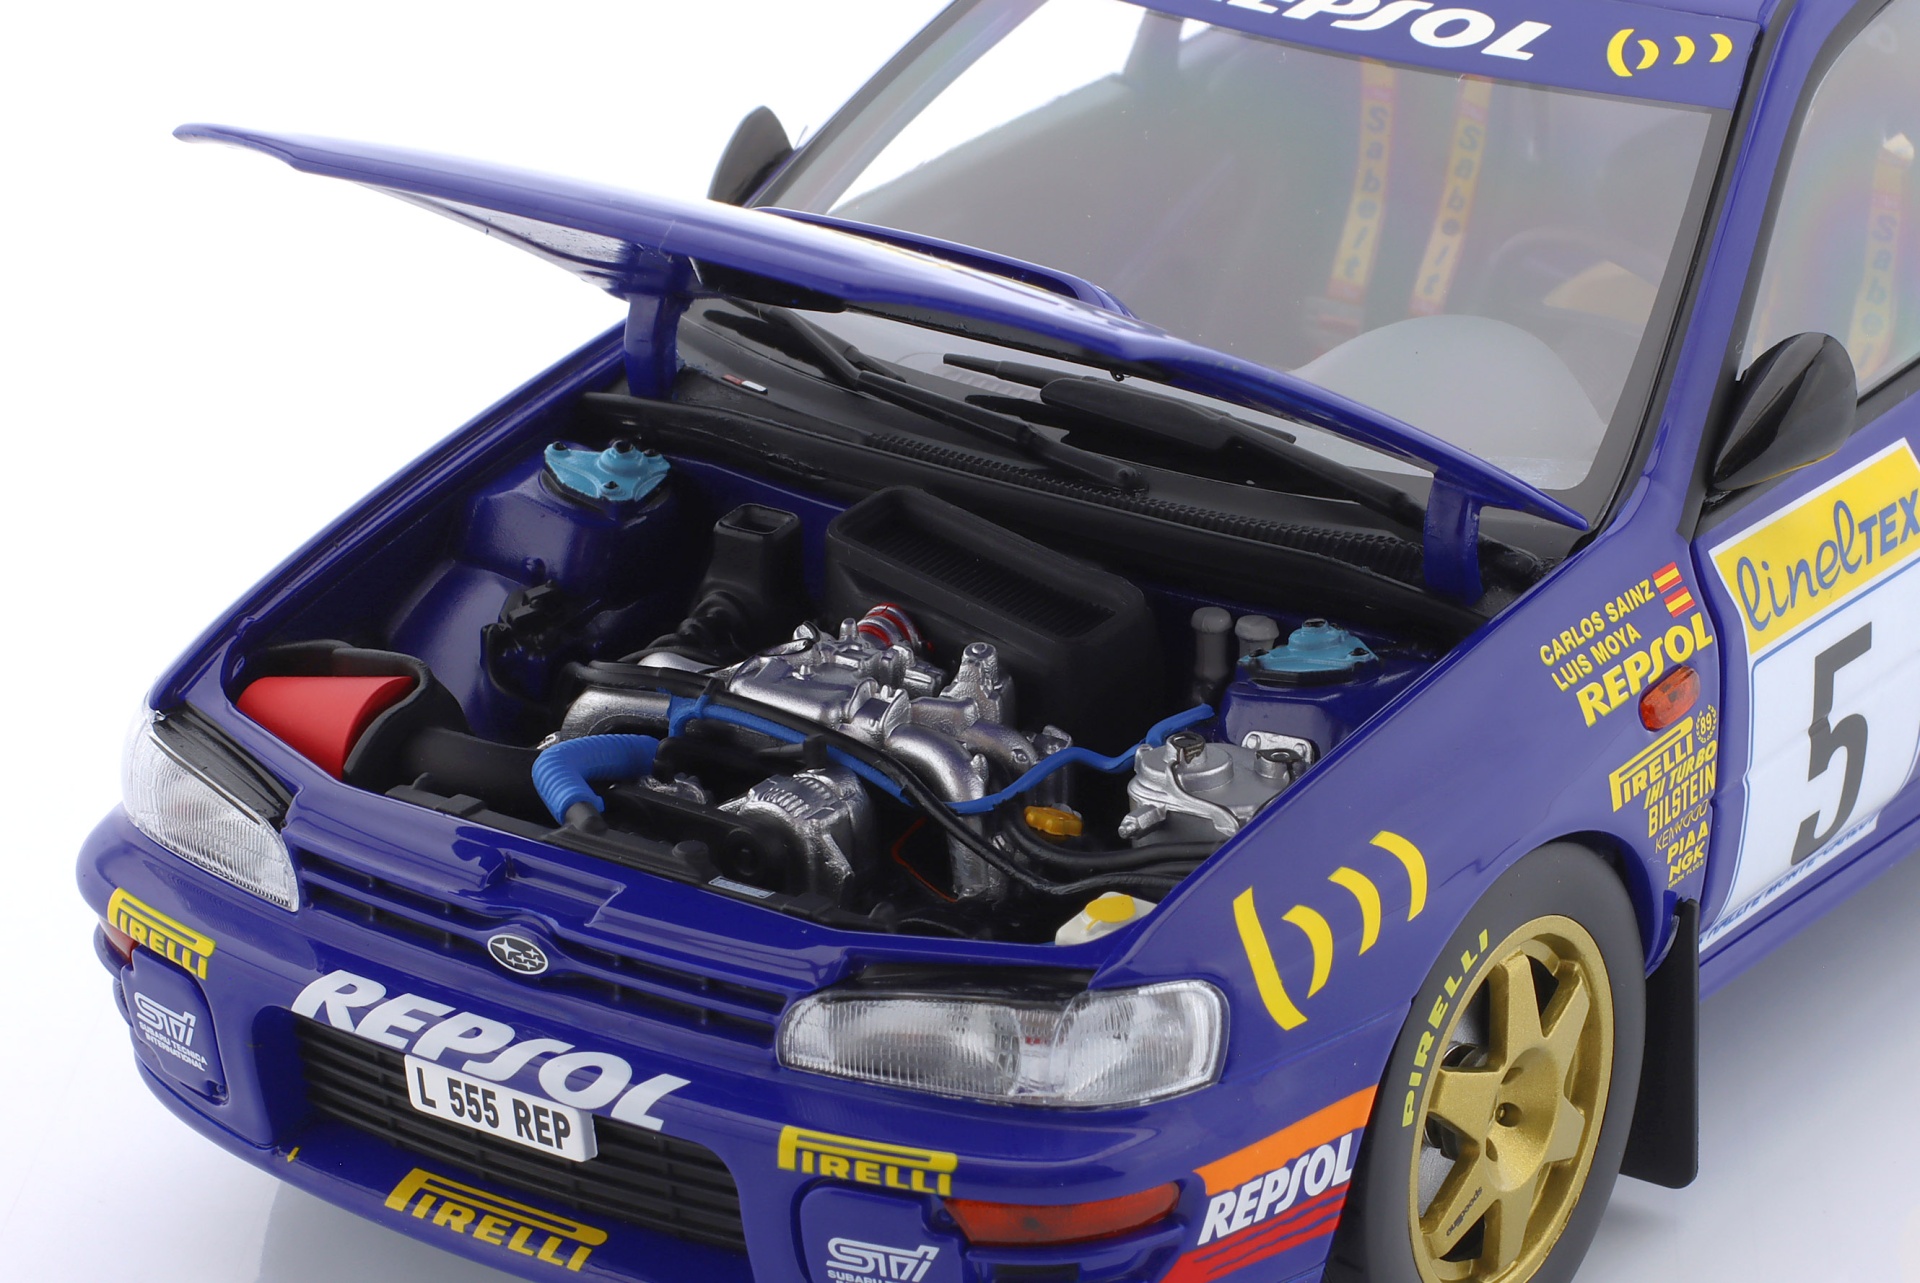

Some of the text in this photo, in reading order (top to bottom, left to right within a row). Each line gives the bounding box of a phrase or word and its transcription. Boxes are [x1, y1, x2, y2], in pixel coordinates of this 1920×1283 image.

[1206, 0, 1552, 61] PSOL
[1539, 579, 1655, 666] CARLOS SAINZ
[1551, 623, 1642, 692] LUIS MOYA
[1576, 612, 1713, 728] REPSOL
[1608, 715, 1694, 813] PIRELLI
[1644, 740, 1717, 810] IHI TURBO
[1792, 621, 1872, 865] 5
[1648, 761, 1716, 838] BILSTEIN
[1655, 799, 1708, 854] KENWOOD
[1667, 820, 1709, 864] PIAA
[1668, 841, 1705, 882] NGK
[107, 886, 215, 980] PIRELLI
[290, 969, 691, 1131] REPSOL
[1402, 928, 1488, 1127] PIRELLI
[416, 1067, 571, 1150] L 555 REP
[777, 1125, 958, 1196] PIRELLI
[1197, 1132, 1353, 1246] REPSOL
[384, 1168, 607, 1272] PIRELLI
